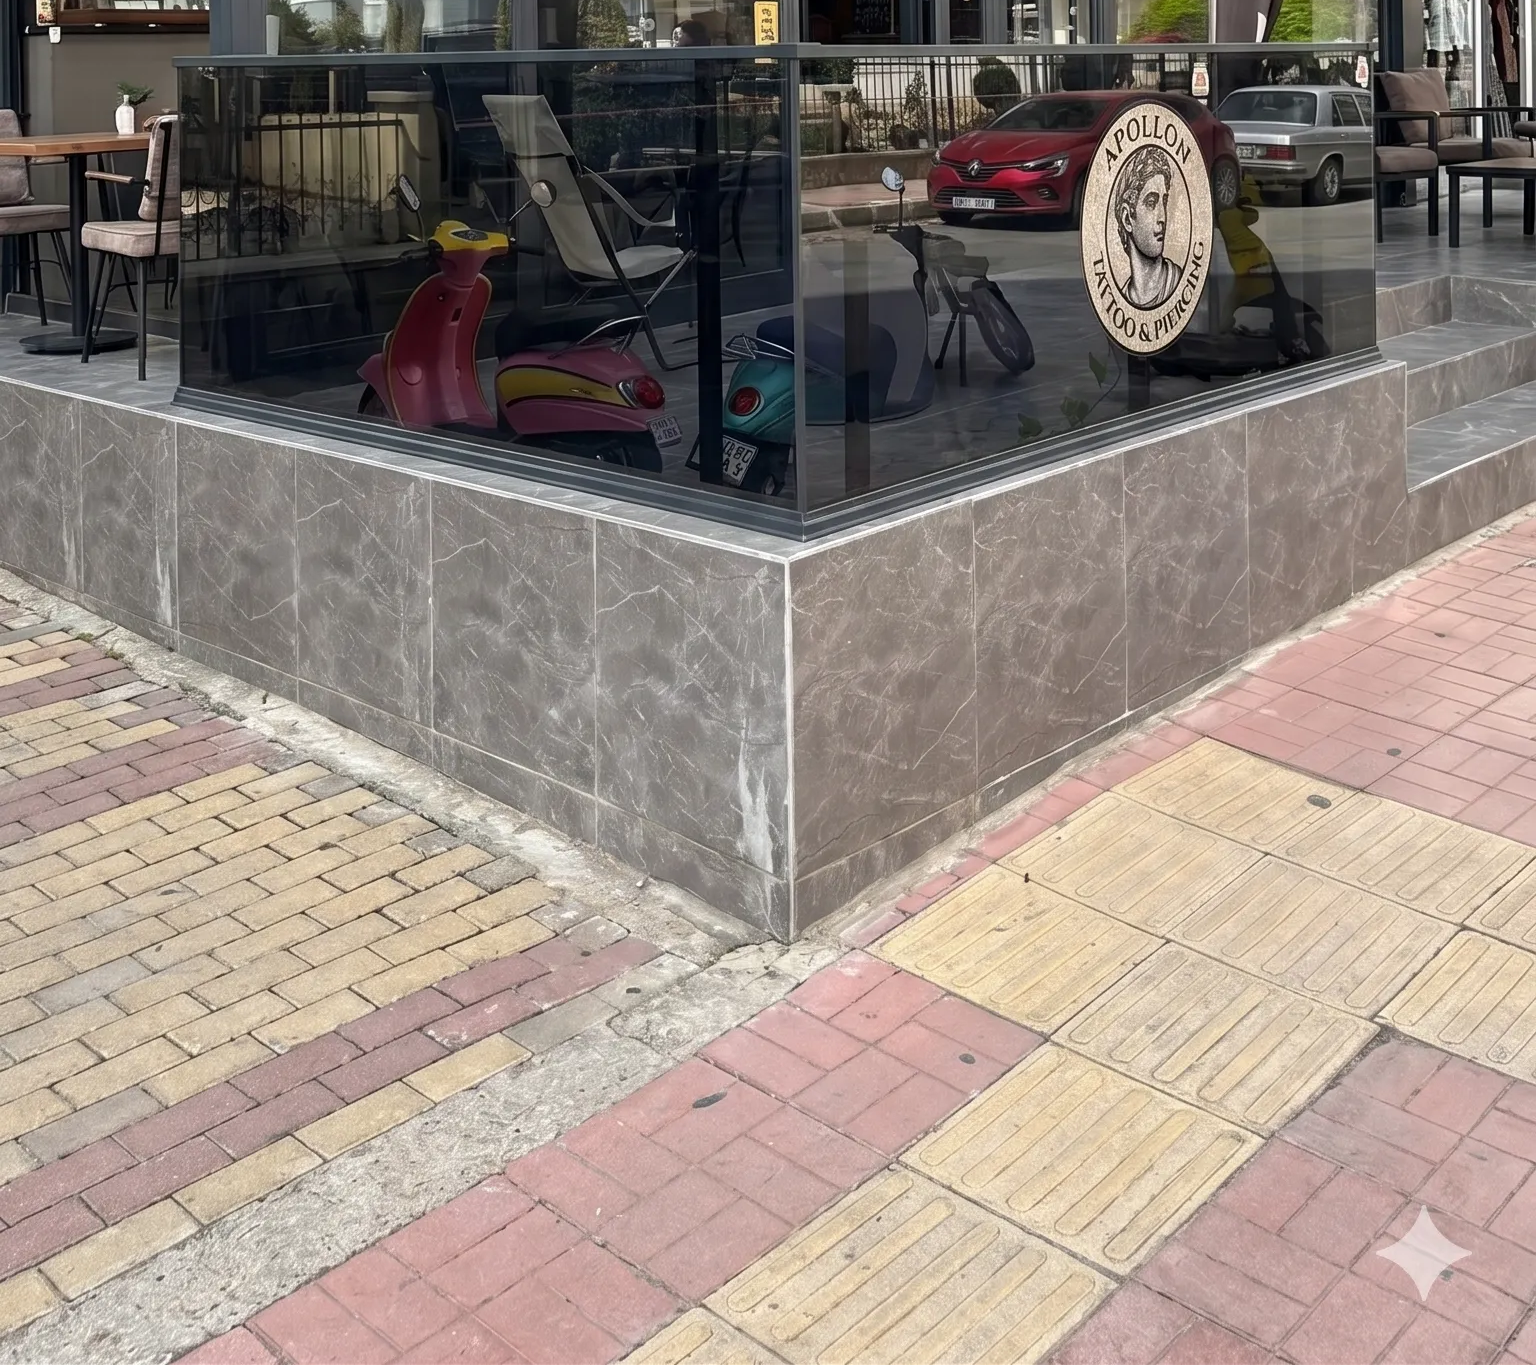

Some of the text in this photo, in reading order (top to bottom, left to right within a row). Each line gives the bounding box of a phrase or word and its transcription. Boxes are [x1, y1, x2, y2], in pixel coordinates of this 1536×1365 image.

[1105, 115, 1190, 172] APOLLON
[1093, 241, 1204, 342] TATTOO & PIERCING
